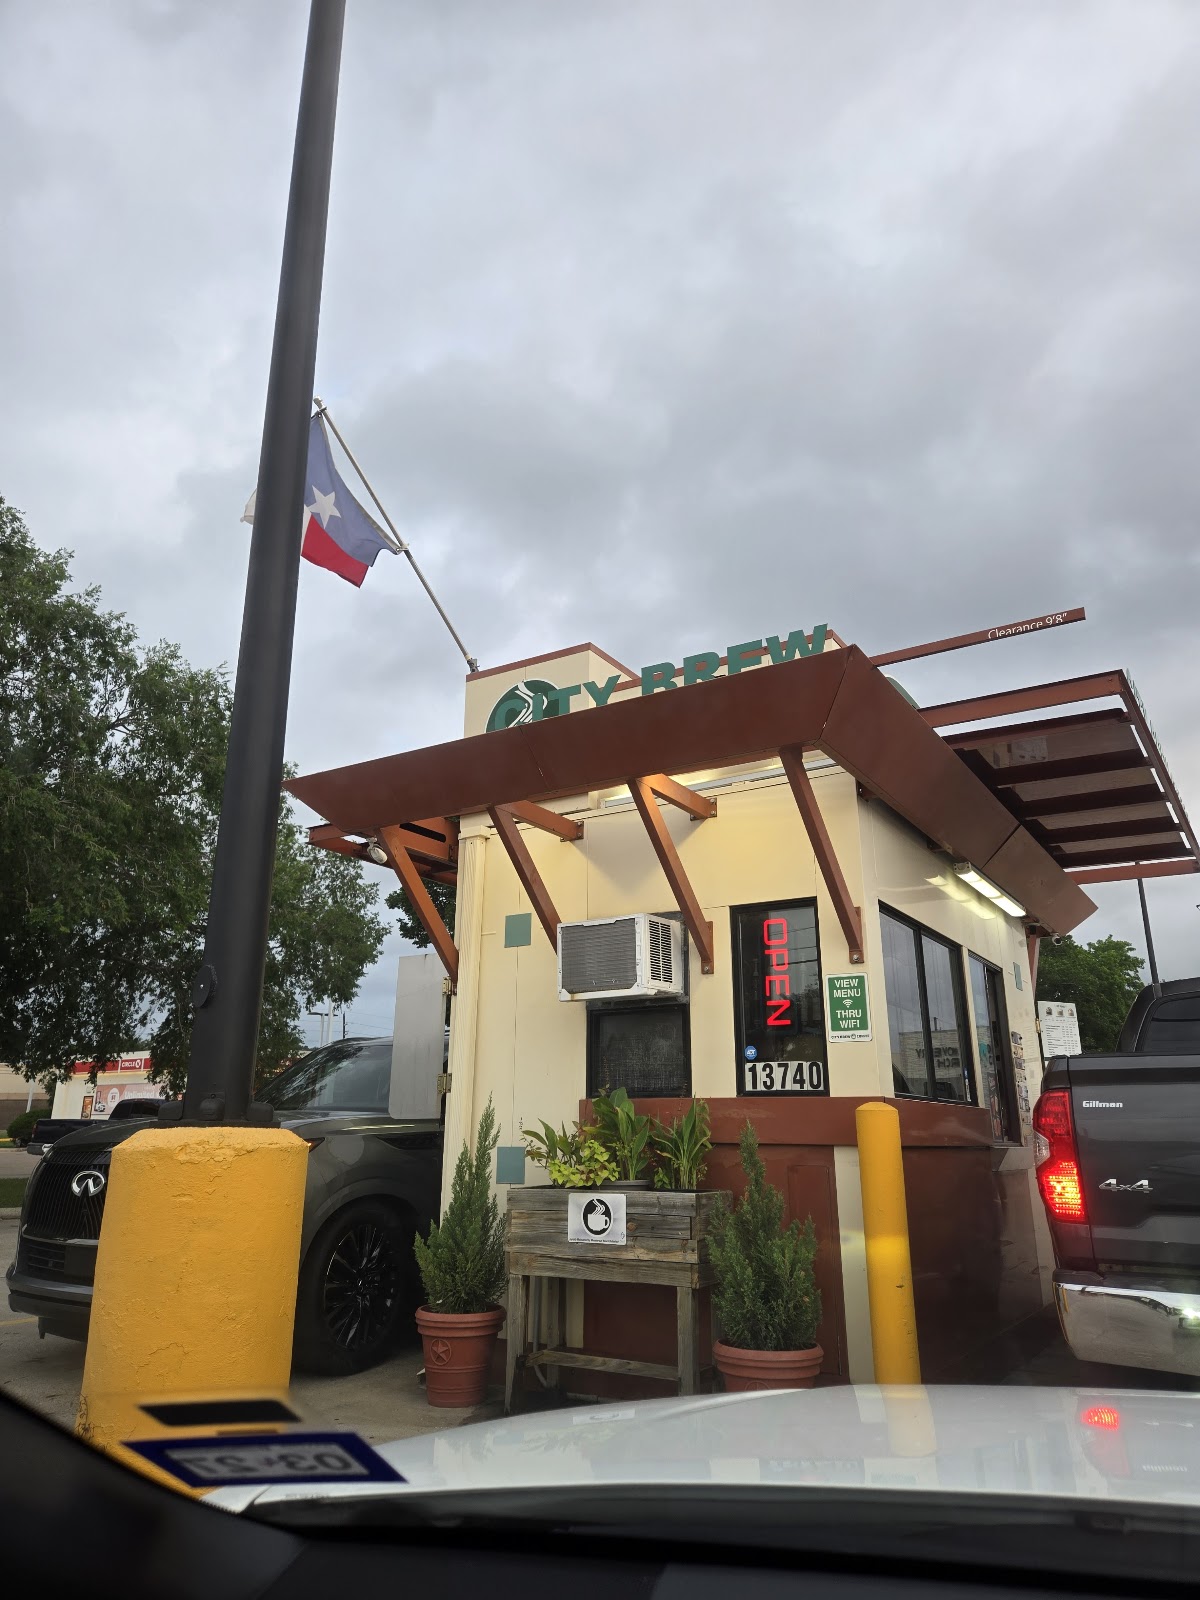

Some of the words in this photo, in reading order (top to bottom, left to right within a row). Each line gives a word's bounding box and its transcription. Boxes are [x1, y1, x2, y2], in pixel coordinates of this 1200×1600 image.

[988, 622, 1043, 639] Clearance
[1045, 612, 1067, 625] 9'8"
[495, 675, 621, 730] CITY
[641, 623, 828, 696] BREW
[763, 918, 791, 1026] OPEN
[834, 979, 858, 988] VIEW
[833, 989, 861, 998] MENU
[836, 1009, 862, 1019] THRU
[839, 1019, 860, 1029] WIFI
[748, 1061, 821, 1090] 13740
[1082, 1100, 1123, 1108] Gillman
[1099, 1178, 1153, 1193] 4x4
